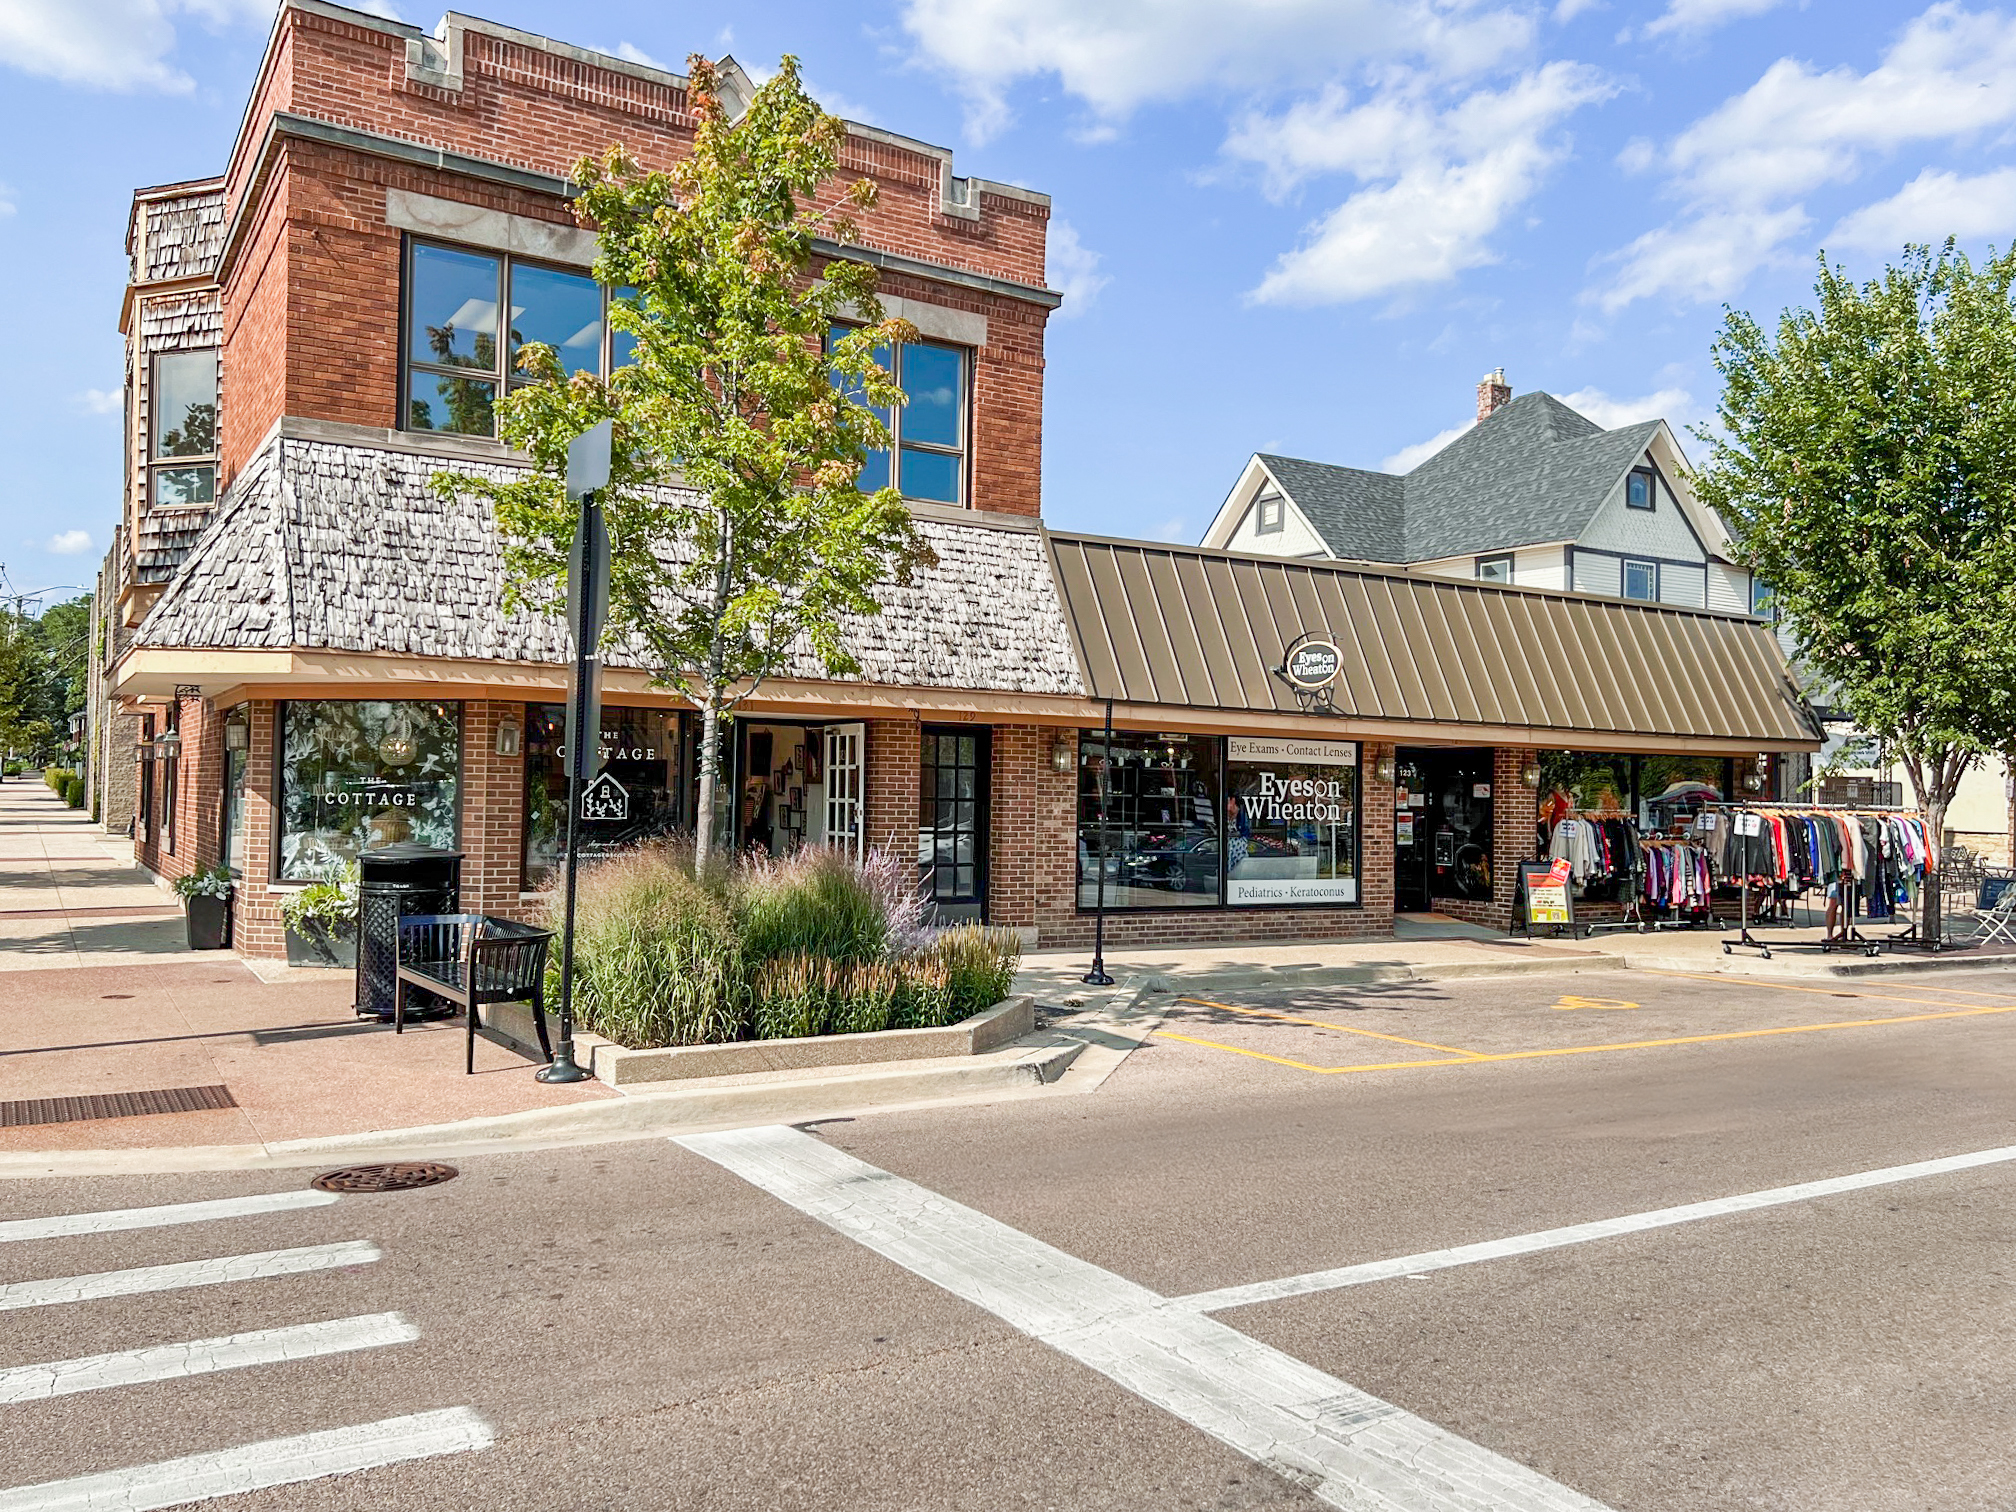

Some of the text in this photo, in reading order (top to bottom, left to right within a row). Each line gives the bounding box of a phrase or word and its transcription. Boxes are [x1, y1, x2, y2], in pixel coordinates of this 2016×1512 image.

[1292, 663, 1335, 676] Wheaton
[958, 711, 976, 721] 129
[599, 731, 619, 739] HE
[556, 745, 655, 760] CTAGE
[1230, 741, 1353, 758] Eye Exams Contact Lenses
[1399, 769, 1412, 777] 123
[359, 776, 382, 784] THE
[324, 792, 417, 806] COTTAGE
[1242, 795, 1341, 821] Wheaton
[1238, 885, 1345, 899] Pediatrics Keratoconus
